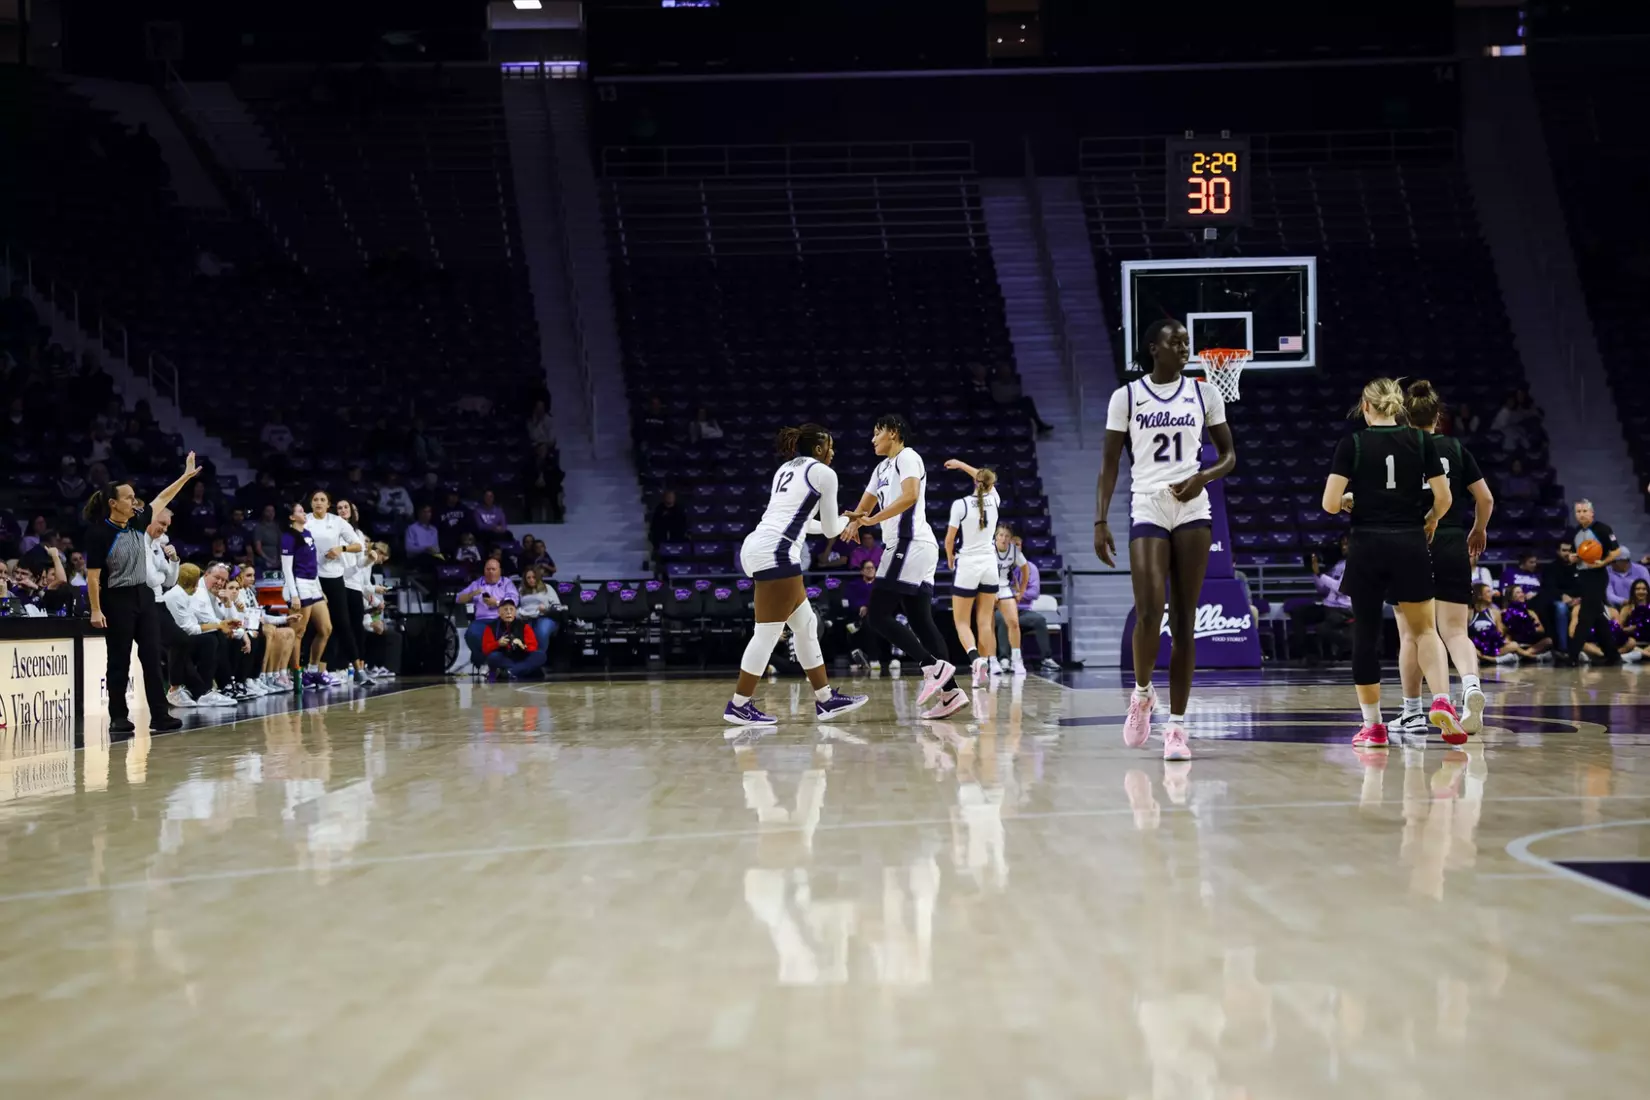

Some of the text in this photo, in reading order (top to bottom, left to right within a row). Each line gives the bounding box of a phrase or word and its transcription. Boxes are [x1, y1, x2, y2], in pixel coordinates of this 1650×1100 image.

[1192, 152, 1237, 174] 2:29
[1188, 177, 1231, 214] 30
[1135, 411, 1196, 430] Wildcats
[1152, 432, 1183, 462] 21
[775, 470, 795, 493] 12
[1385, 454, 1397, 489] 1
[10, 645, 69, 679] Ascension
[11, 691, 31, 726] Via
[33, 688, 72, 724] Christi
